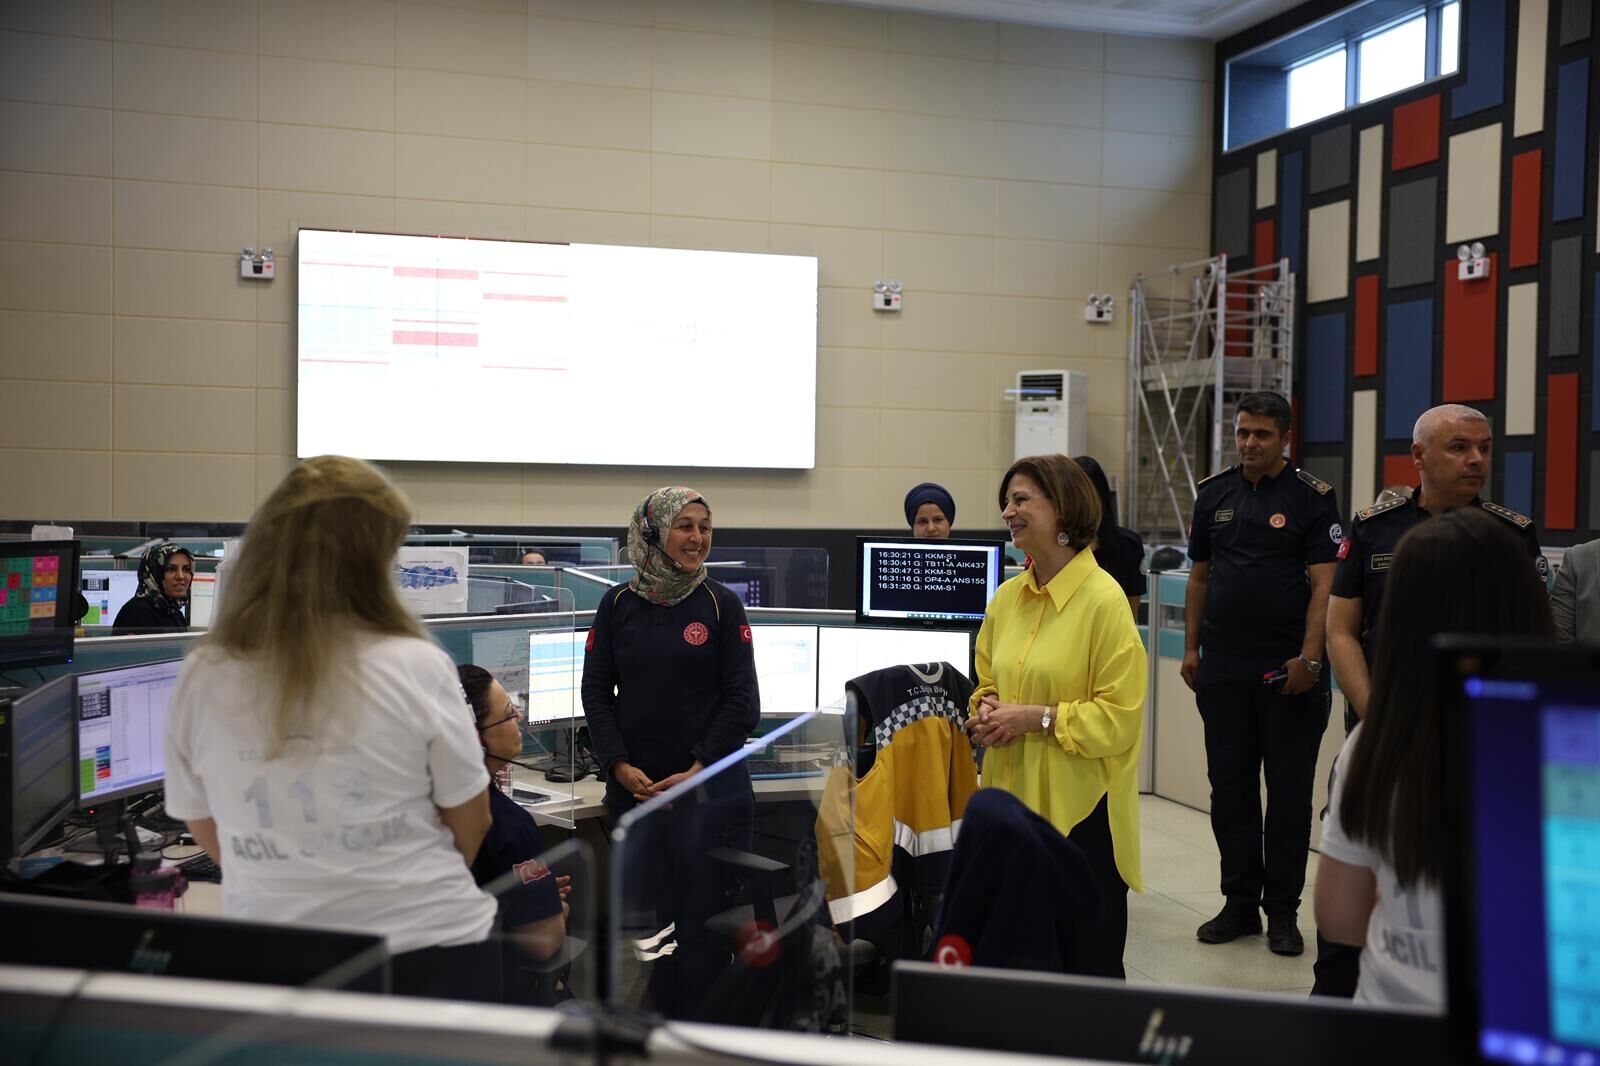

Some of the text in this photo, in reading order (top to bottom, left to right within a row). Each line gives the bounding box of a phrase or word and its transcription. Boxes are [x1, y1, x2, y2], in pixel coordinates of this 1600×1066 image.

[878, 559, 911, 567] 16:30:41
[925, 576, 950, 584] OP4-A
[952, 577, 985, 585] ANS155
